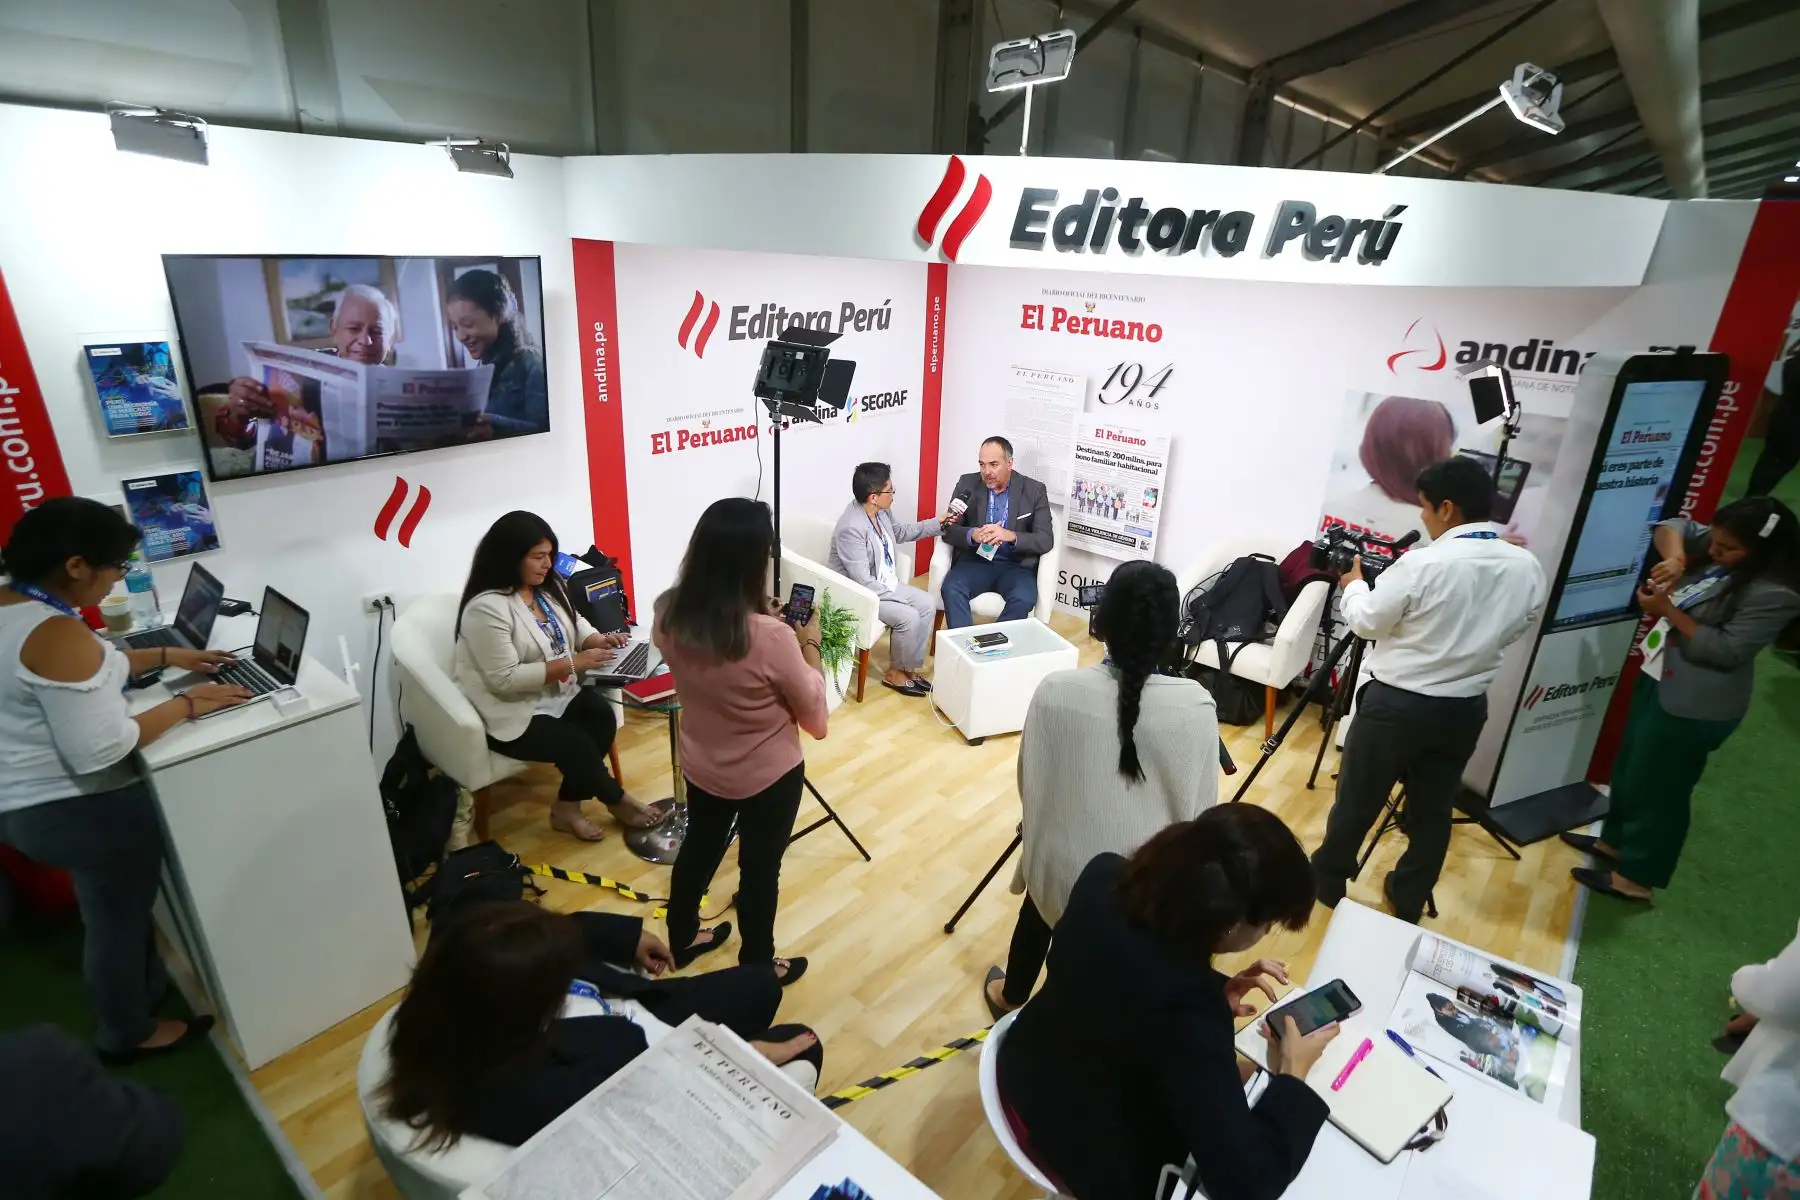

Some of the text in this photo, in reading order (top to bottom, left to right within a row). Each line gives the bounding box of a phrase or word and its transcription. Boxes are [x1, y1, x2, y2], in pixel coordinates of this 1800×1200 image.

[1009, 187, 1408, 265] Editora Perú
[729, 299, 892, 341] Editora Perú
[930, 296, 941, 373] elperuano.pe
[1020, 304, 1163, 343] El Peruano
[594, 321, 608, 402] andina.pe
[1098, 360, 1174, 405] 194
[792, 405, 838, 424] aina
[861, 389, 908, 413] SEGRAF
[1128, 399, 1160, 410] AÑOS
[651, 424, 758, 455] El Peruano
[1095, 428, 1147, 446] El Peruano
[1620, 430, 1672, 445] El Peruano
[1075, 452, 1158, 476] bono familiar habitacional
[1076, 444, 1105, 456] Destinan
[1112, 451, 1125, 460] 200
[1146, 460, 1162, 468] para
[1542, 671, 1620, 702] Editora Perú
[693, 1041, 713, 1058] EL
[717, 1059, 792, 1119] PERUANO
